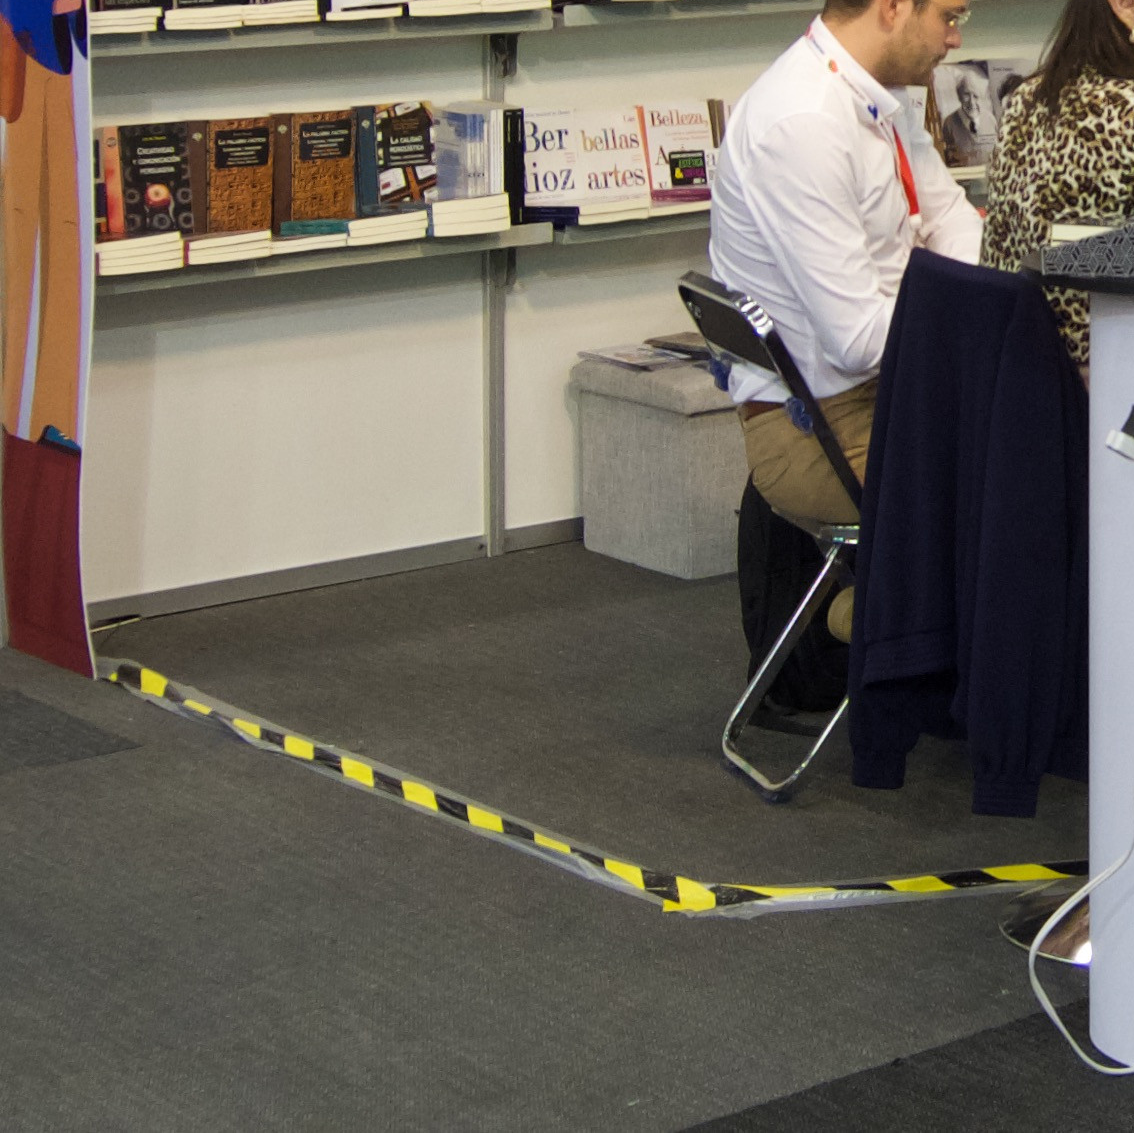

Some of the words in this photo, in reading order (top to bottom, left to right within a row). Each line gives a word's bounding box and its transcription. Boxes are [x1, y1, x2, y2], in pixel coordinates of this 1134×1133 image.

[525, 121, 568, 153] Ber
[580, 128, 640, 152] bellas
[587, 164, 646, 190] artes
